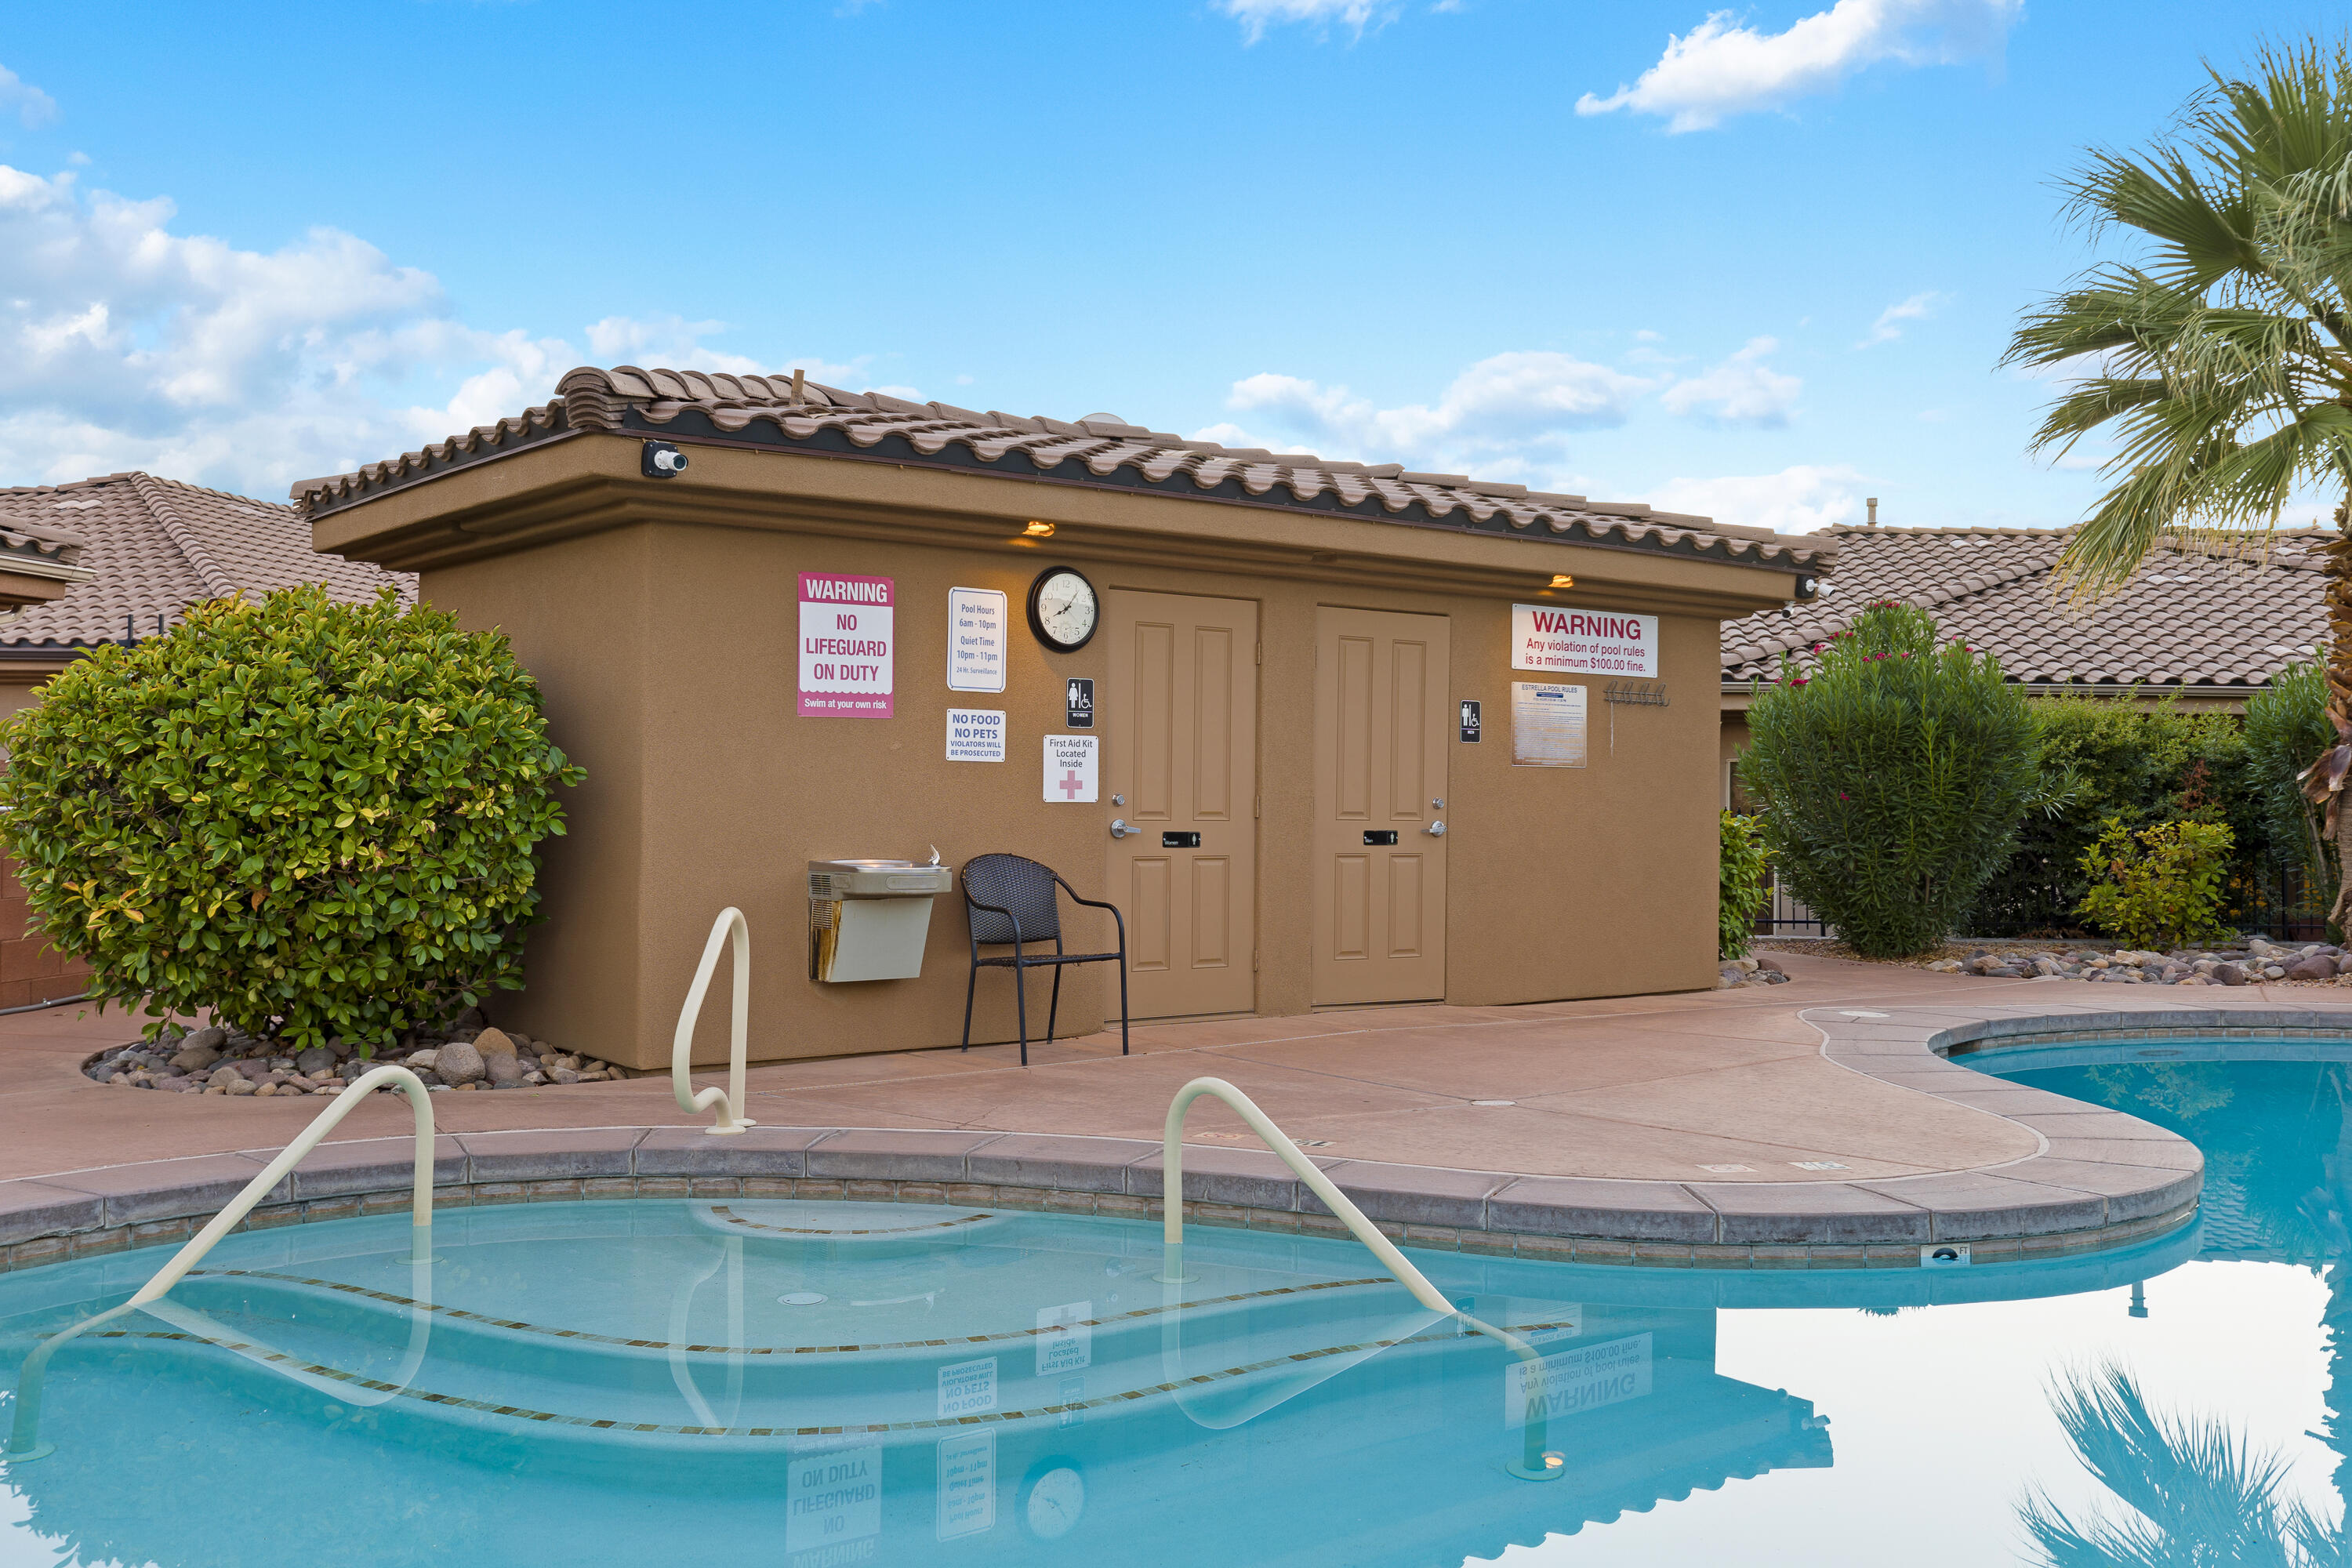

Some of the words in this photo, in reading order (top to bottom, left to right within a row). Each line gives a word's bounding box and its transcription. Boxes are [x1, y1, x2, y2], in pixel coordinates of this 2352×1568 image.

[805, 579, 887, 603] WARNING
[961, 604, 975, 613] Pool
[977, 605, 995, 615] Hours
[837, 614, 858, 631] NO
[959, 619, 973, 627] 6am
[978, 619, 996, 630] 10pm
[1532, 611, 1641, 641] WARNING
[960, 635, 978, 645] Quiet
[979, 637, 995, 646] Time
[806, 637, 887, 657] LIFEGUARD
[1526, 637, 1544, 652] Any
[1547, 640, 1587, 653] violation
[1589, 643, 1599, 654] of
[1601, 644, 1621, 656] pool
[1624, 646, 1645, 657] rules
[956, 650, 975, 661] 10pm
[980, 652, 997, 662] 11pm
[1526, 653, 1534, 665] is
[1536, 656, 1542, 665] a
[1544, 655, 1588, 668] minimum
[1590, 657, 1624, 670] $100.00
[1627, 660, 1646, 672] fine.
[814, 663, 834, 680] ON
[840, 664, 879, 681] DUTY
[970, 666, 997, 675] Surveillance
[804, 698, 826, 707] Swim
[837, 701, 854, 710] your
[873, 700, 887, 710] risk
[953, 713, 968, 724] NO
[971, 714, 1000, 725] FOOD
[954, 728, 971, 738] NO
[973, 728, 998, 739] PETS
[1050, 739, 1066, 747] First
[1068, 739, 1080, 748] Aid
[1082, 739, 1093, 748] Kit
[1060, 759, 1083, 768] Inside
